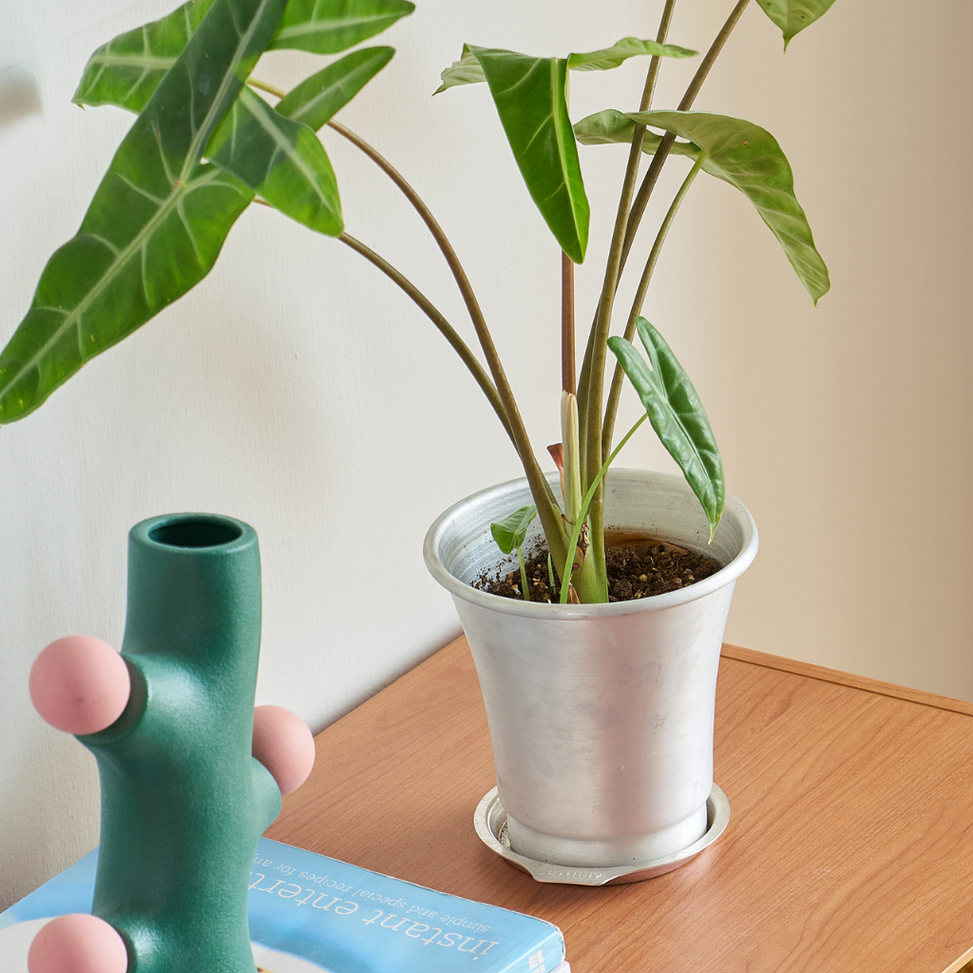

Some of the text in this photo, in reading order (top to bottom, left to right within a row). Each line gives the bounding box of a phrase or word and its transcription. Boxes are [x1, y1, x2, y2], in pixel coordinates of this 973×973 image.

[248, 870, 500, 961] instant entert
[253, 853, 491, 934] simple and special recipes for an
